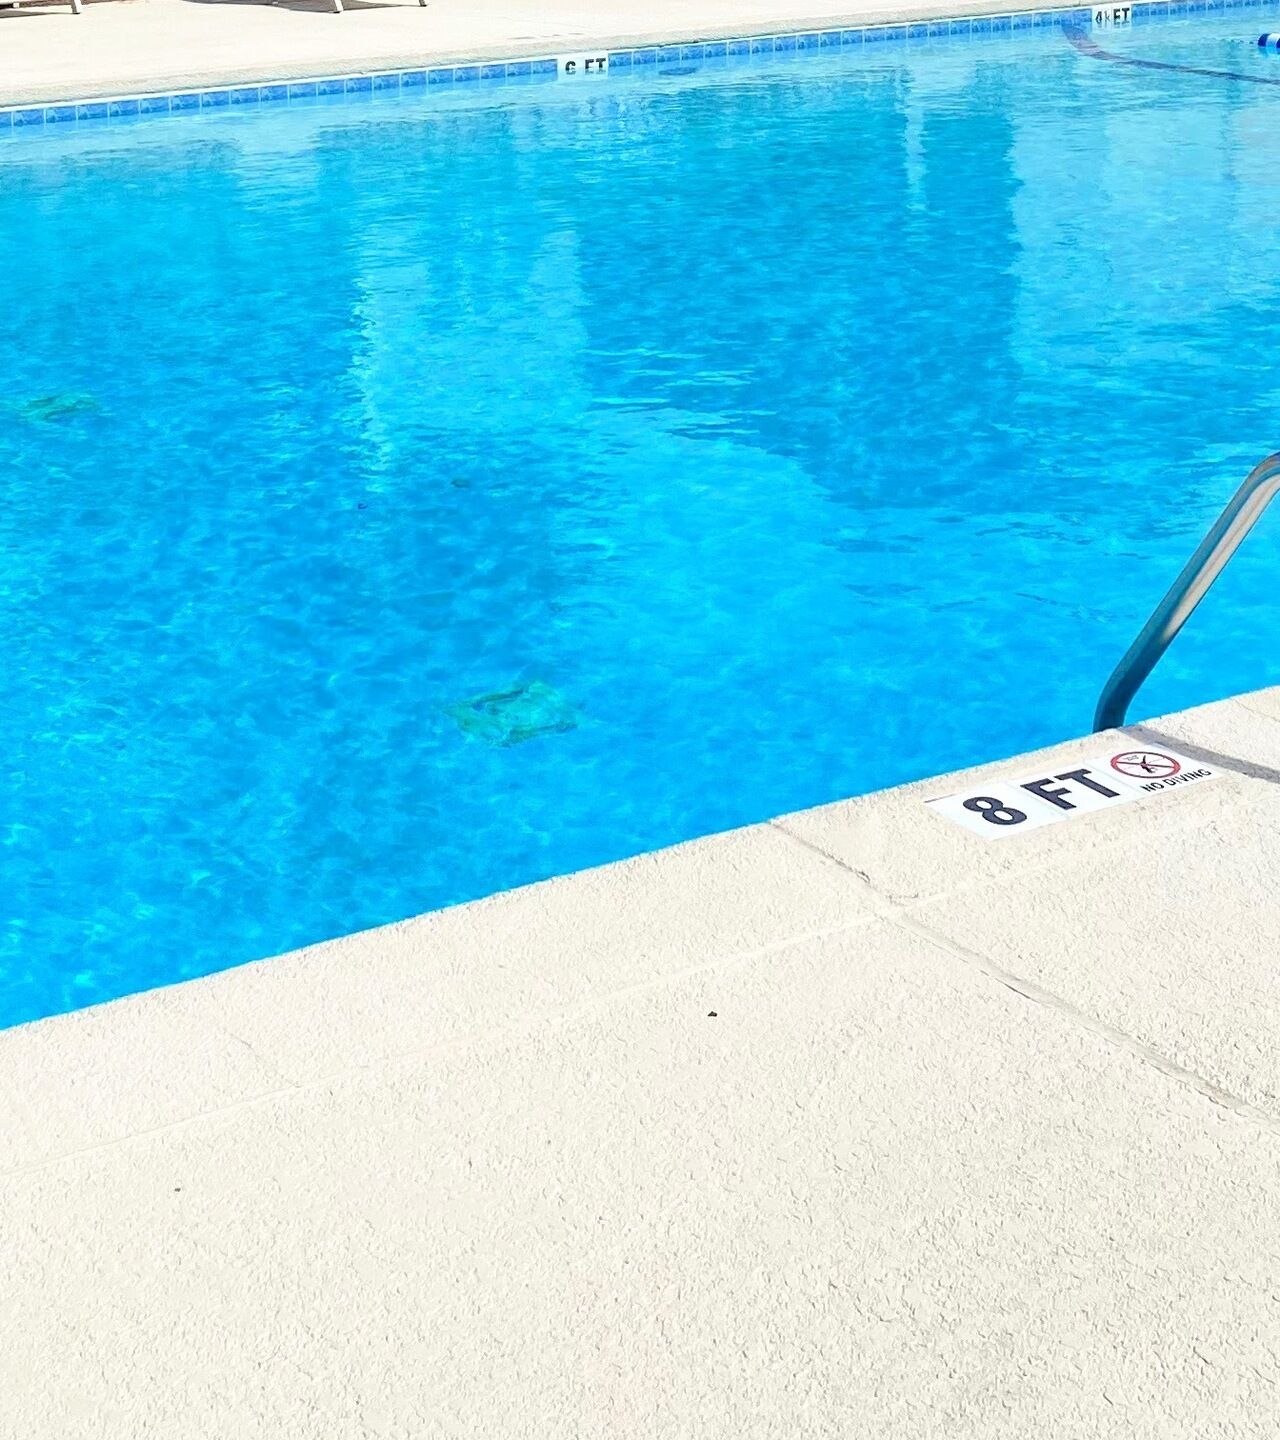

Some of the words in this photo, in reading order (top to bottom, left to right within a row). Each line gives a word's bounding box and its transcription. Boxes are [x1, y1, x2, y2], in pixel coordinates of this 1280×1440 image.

[962, 795, 1027, 826] 8
[1019, 767, 1120, 811] FT
[1140, 781, 1165, 792] NO
[1162, 768, 1212, 786] DIVING
